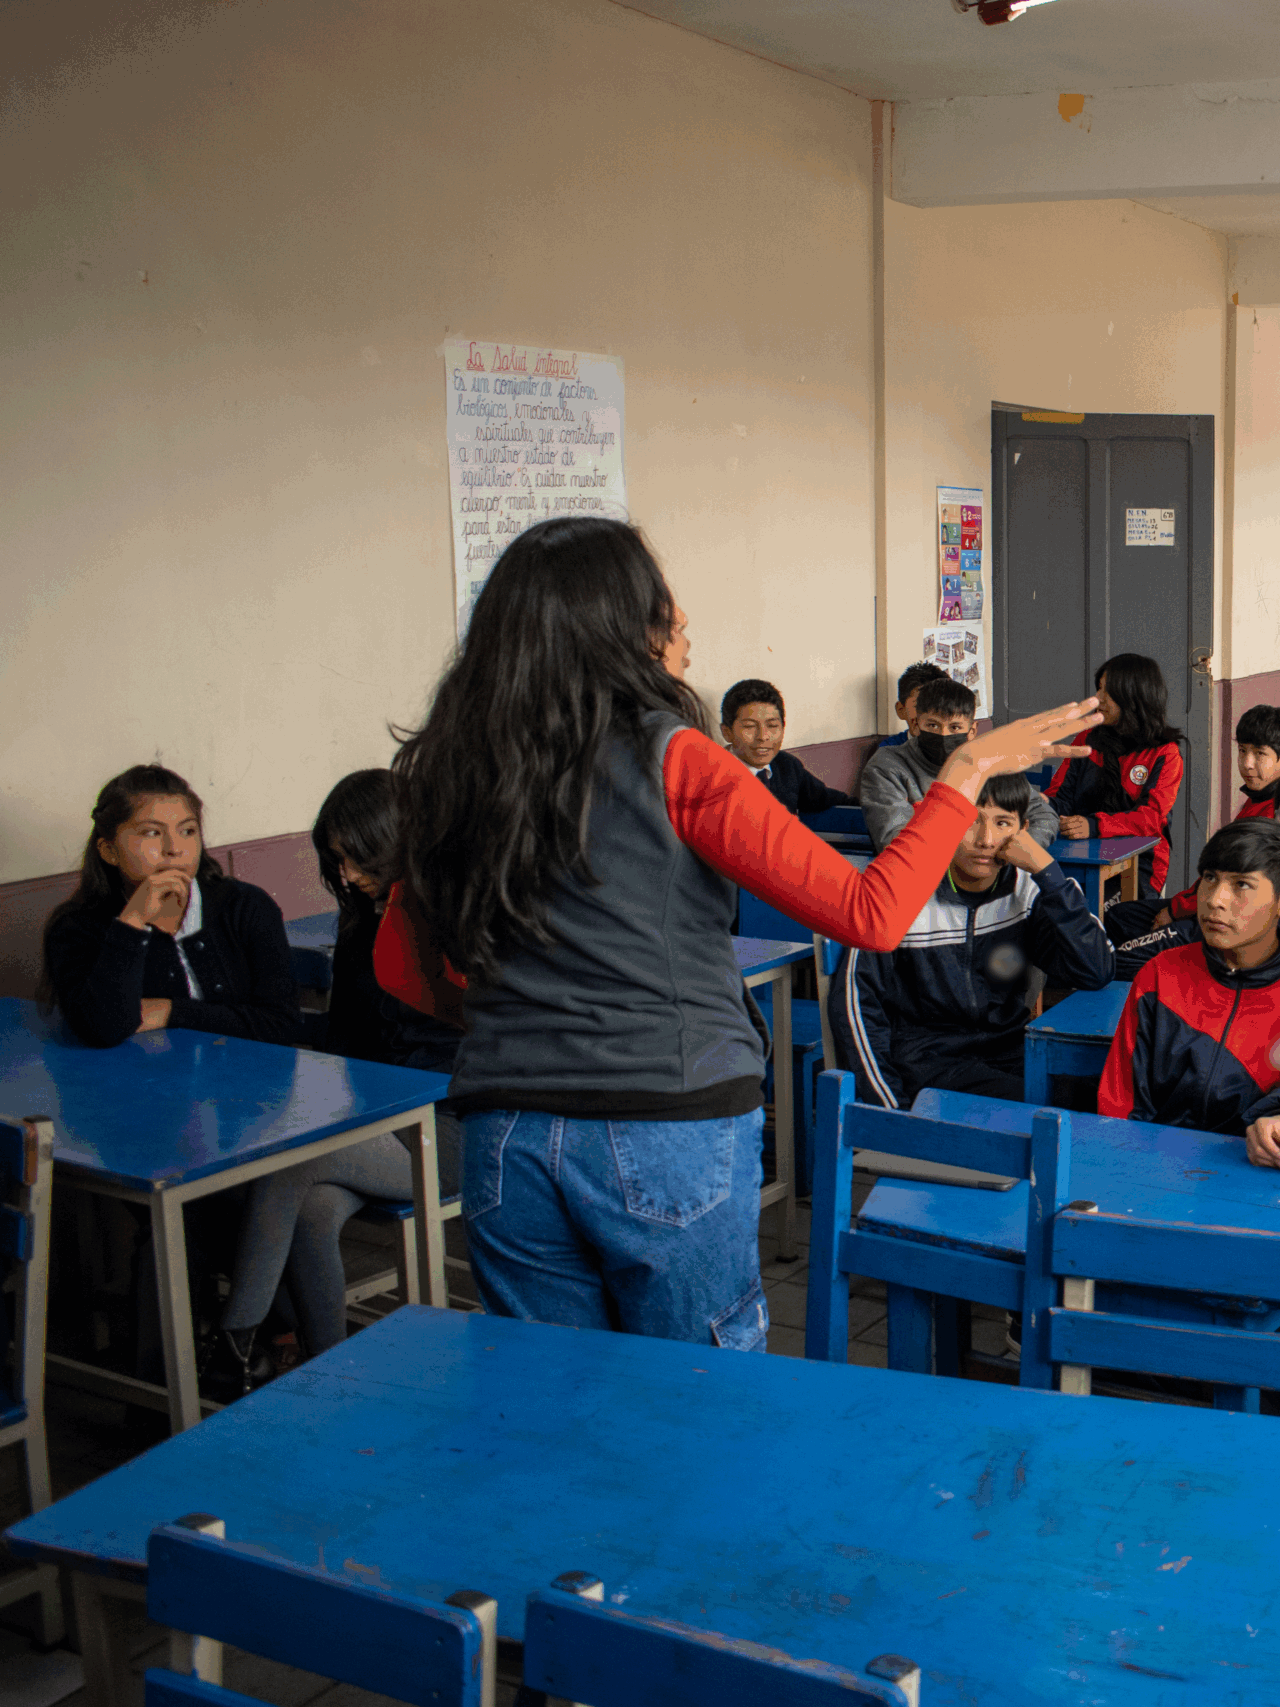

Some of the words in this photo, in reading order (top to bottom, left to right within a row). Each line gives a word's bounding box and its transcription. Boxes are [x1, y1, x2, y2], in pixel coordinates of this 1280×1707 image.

[466, 341, 485, 368] La
[491, 345, 528, 371] Salud
[533, 352, 578, 379] integral
[453, 368, 467, 391] Es
[471, 377, 490, 393] un
[493, 375, 539, 400] conjunto
[540, 378, 552, 397] de
[514, 401, 575, 422] emocionales
[582, 411, 592, 432] y
[474, 421, 533, 447] espirituales
[538, 428, 554, 449] que
[559, 424, 615, 455] contribuyen
[458, 447, 468, 463] a
[475, 444, 521, 464] nuestro
[524, 443, 558, 465] estado
[561, 446, 575, 466] de
[535, 467, 566, 487] cuidar
[570, 465, 609, 487] nuestro
[505, 488, 537, 510] mente
[541, 496, 550, 519] y
[554, 493, 605, 511] emociones
[967, 510, 972, 520] 2
[461, 520, 490, 544] para
[495, 514, 522, 534] estar
[965, 538, 969, 548] 4
[944, 606, 949, 616] 9
